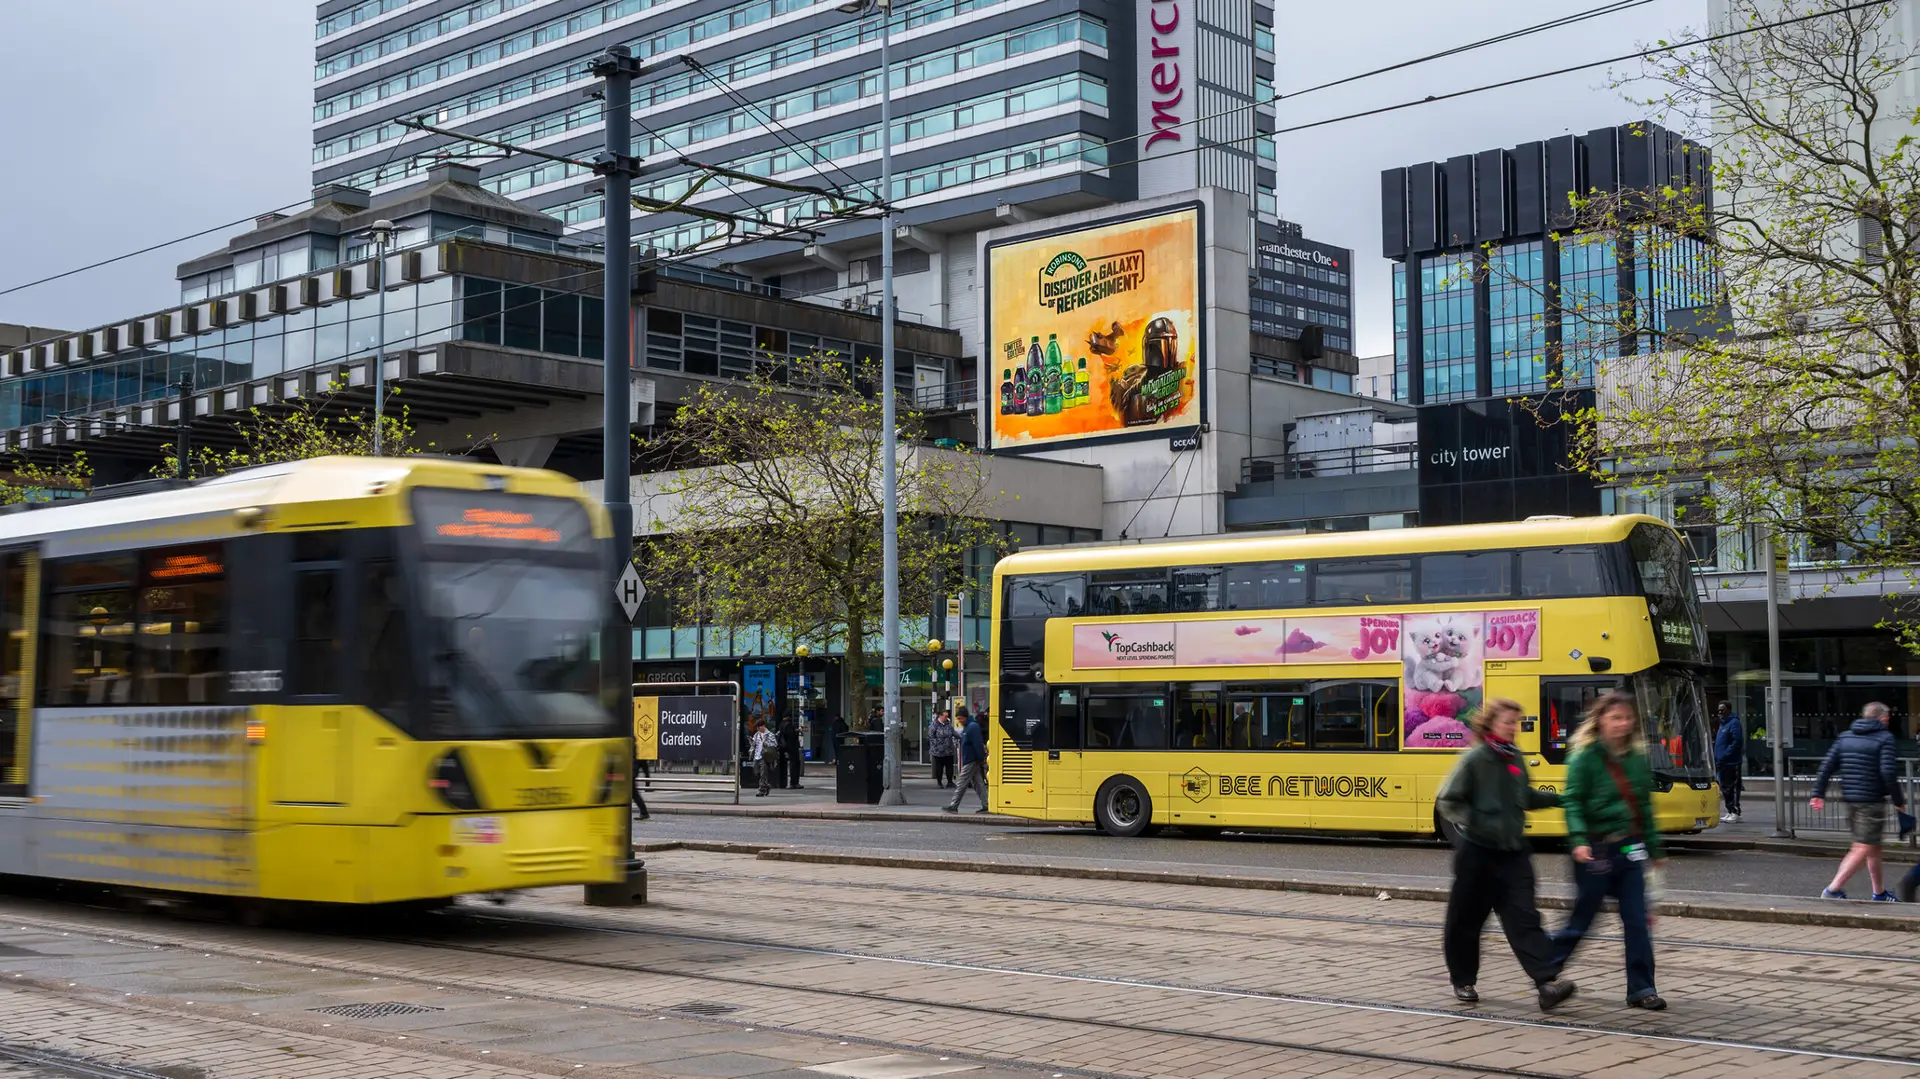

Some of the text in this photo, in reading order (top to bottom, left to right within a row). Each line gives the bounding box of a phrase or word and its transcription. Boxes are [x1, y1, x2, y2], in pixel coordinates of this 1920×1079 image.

[1145, 0, 1183, 152] merc
[1047, 252, 1085, 275] ROBINSONS
[1044, 254, 1140, 298] DISCOVER A GALAXY
[1048, 272, 1139, 315] OF REFRESHMENT
[1154, 398, 1179, 416] MAY 22
[1173, 438, 1196, 447] OCEAN
[1430, 445, 1511, 467] city tower
[624, 580, 637, 603] H
[1360, 616, 1399, 628] SPENDING
[1490, 611, 1536, 625] CASHBACK
[1115, 641, 1174, 655] TopCashback
[1351, 627, 1399, 660] JOY
[1486, 623, 1537, 657] JOY
[648, 672, 686, 683] GREGGS
[661, 710, 708, 728] Piccadilly
[661, 731, 702, 746] Gardens
[1219, 775, 1388, 798] BEE NETWORK
